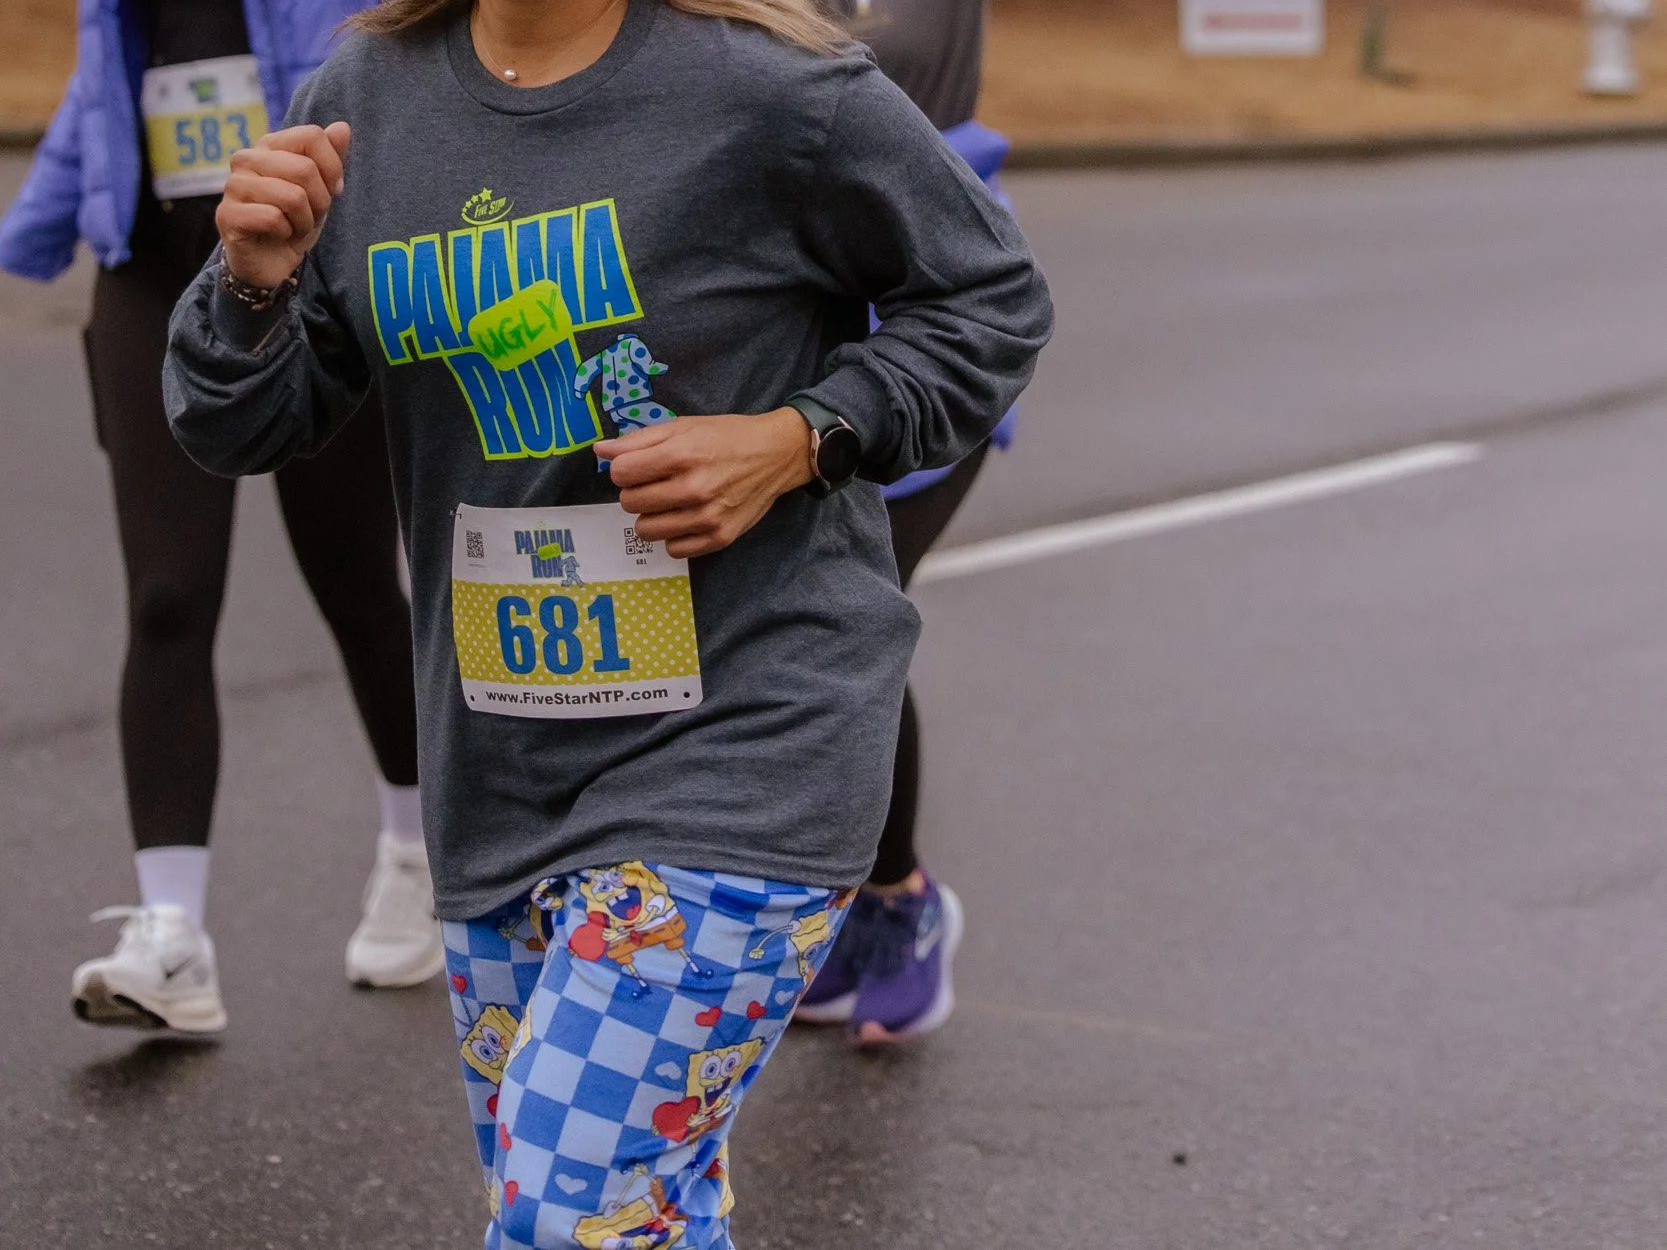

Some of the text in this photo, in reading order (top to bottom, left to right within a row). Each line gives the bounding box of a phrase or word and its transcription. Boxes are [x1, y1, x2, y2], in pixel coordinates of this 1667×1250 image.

[174, 113, 253, 166] 583
[368, 198, 644, 366] PAJAMA
[477, 289, 558, 360] UGLY
[446, 338, 603, 460] RUN
[496, 593, 631, 676] 681
[485, 686, 669, 706] www.FiveStarNTP.com
